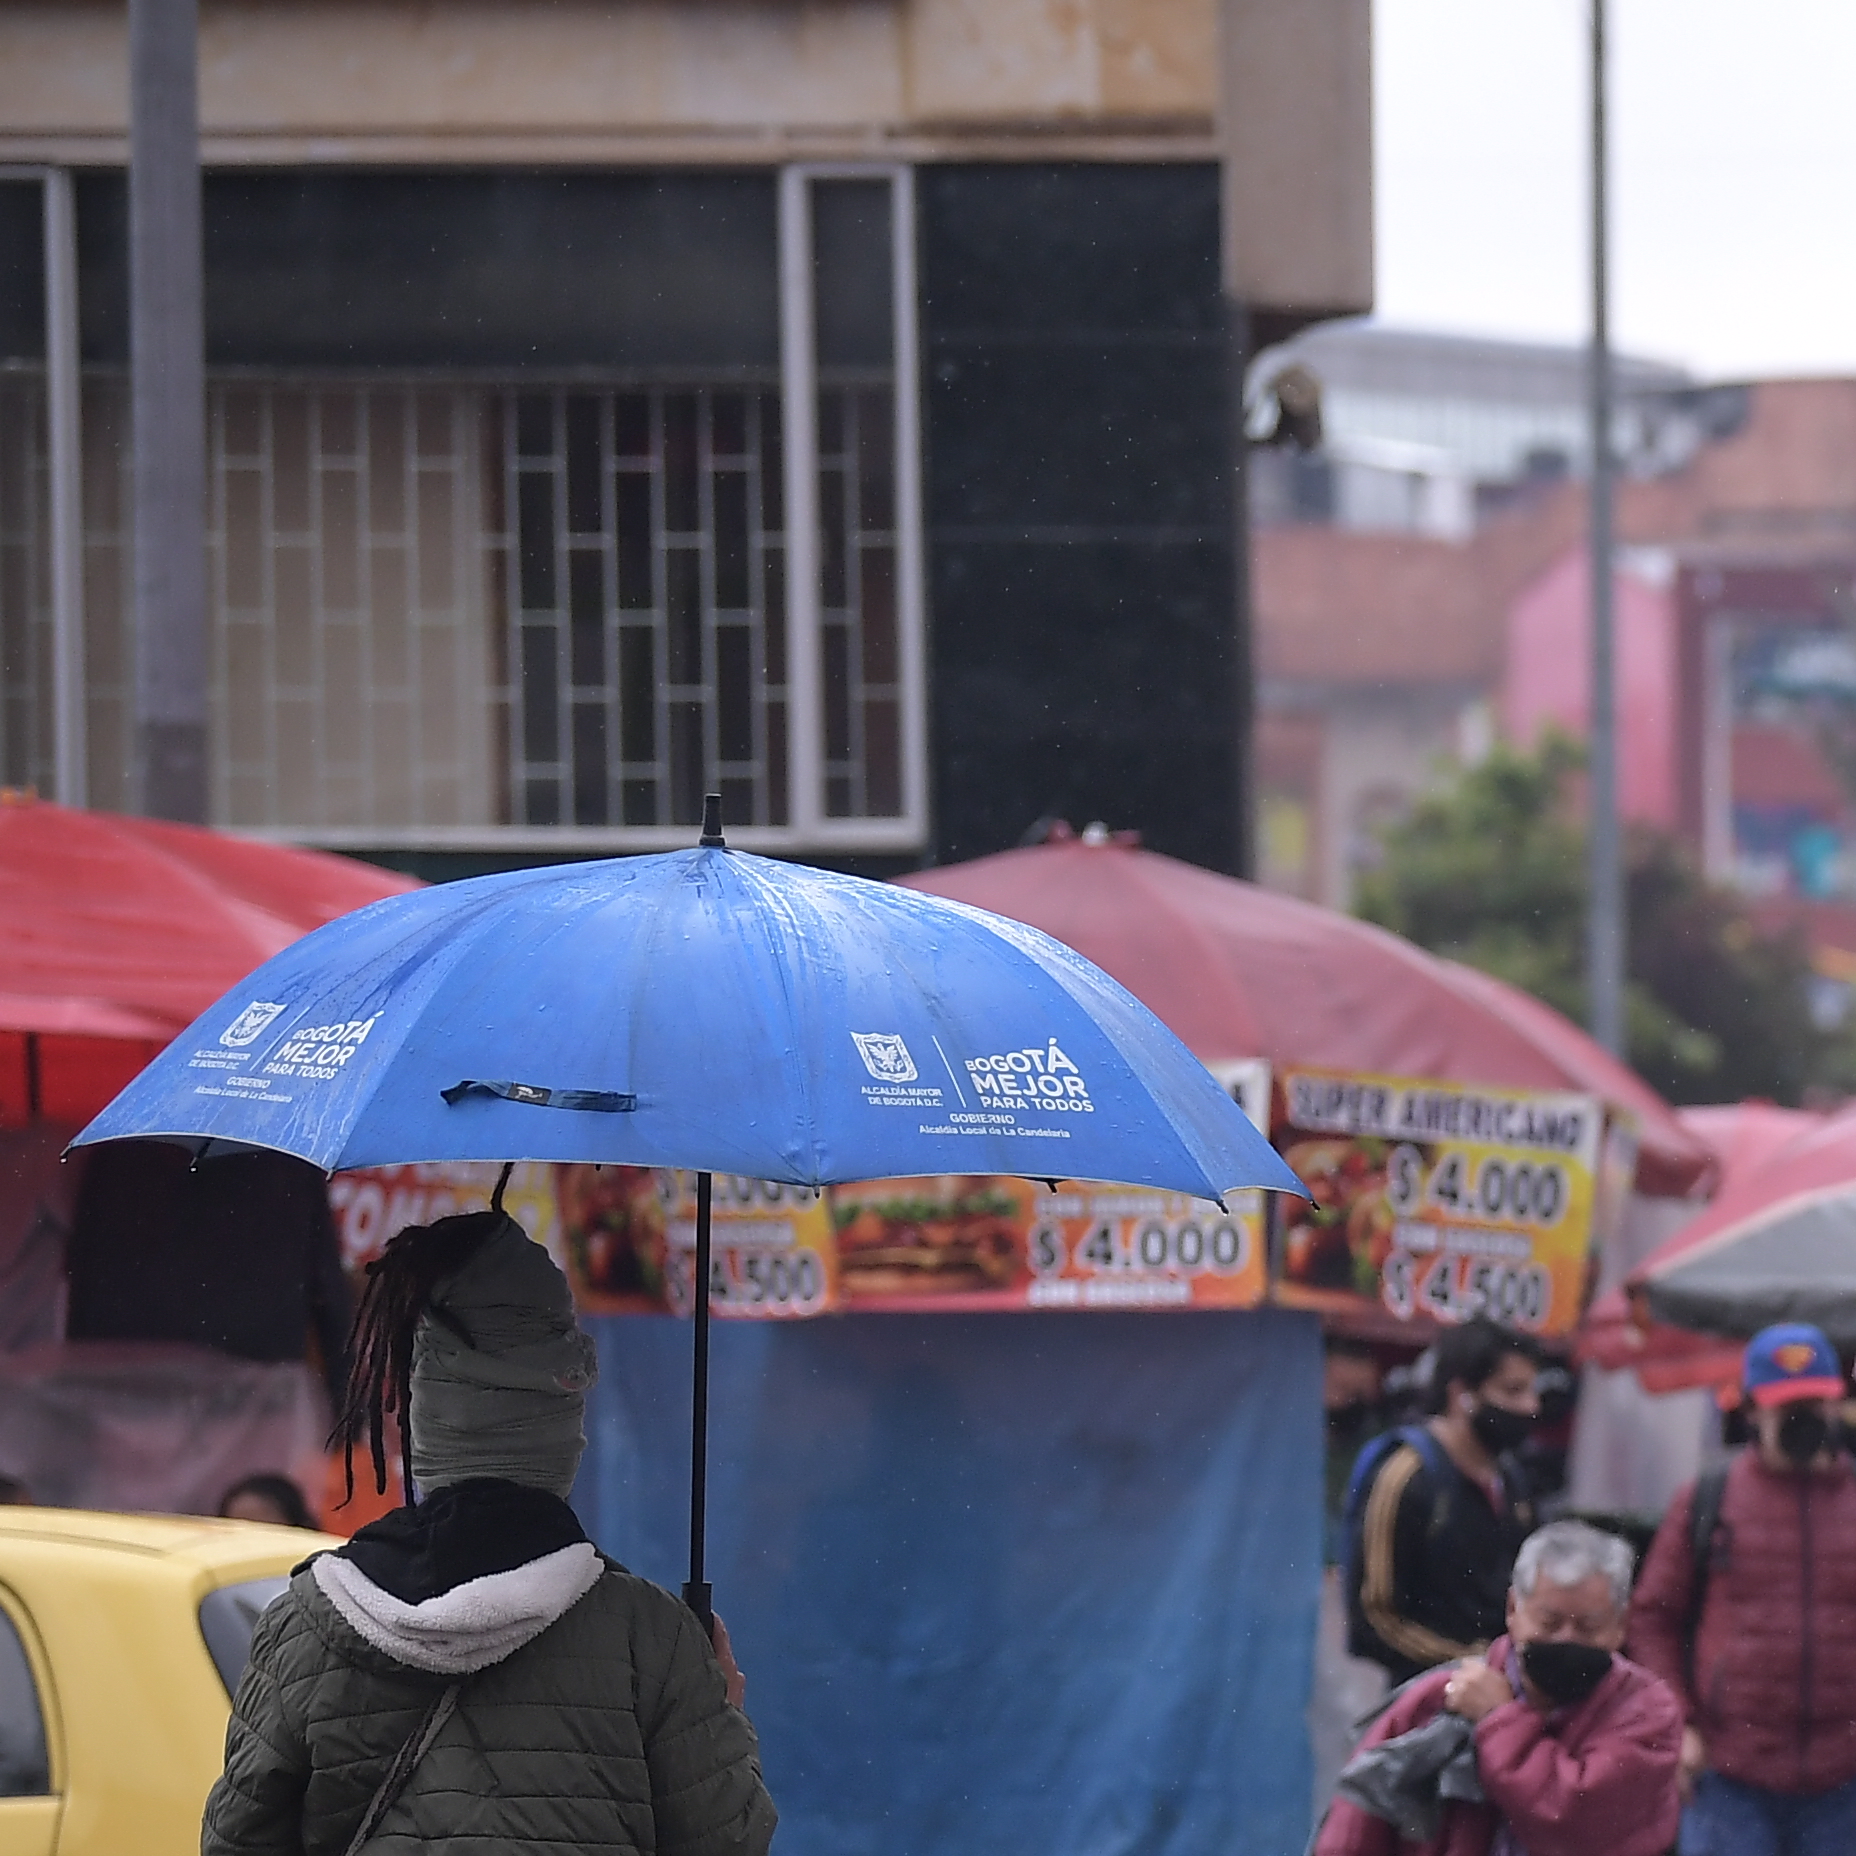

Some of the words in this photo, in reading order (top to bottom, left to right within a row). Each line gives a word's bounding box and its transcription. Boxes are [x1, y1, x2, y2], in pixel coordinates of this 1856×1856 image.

[292, 1010, 385, 1044] BOGOTÁ
[273, 1041, 356, 1066] MEJOR
[964, 1037, 1079, 1074] BOGOTÁ
[262, 1062, 296, 1076] PARA
[296, 1065, 338, 1080] TODOS
[861, 1085, 908, 1096] ALCALDÍA
[908, 1088, 943, 1097] MAYOR
[969, 1072, 1089, 1098] MEJOR
[867, 1096, 883, 1105] DE
[979, 1095, 1030, 1110] PARA
[1031, 1097, 1095, 1112] TODOS
[949, 1113, 1015, 1125] GOBIERNO
[959, 1125, 987, 1135] Local
[988, 1126, 1001, 1135] de
[1002, 1126, 1016, 1136] La
[1016, 1127, 1071, 1138] Candelaria
[1434, 1157, 1564, 1223] 4.000
[1082, 1221, 1241, 1268] 4.000
[1428, 1263, 1547, 1321] 4.500
